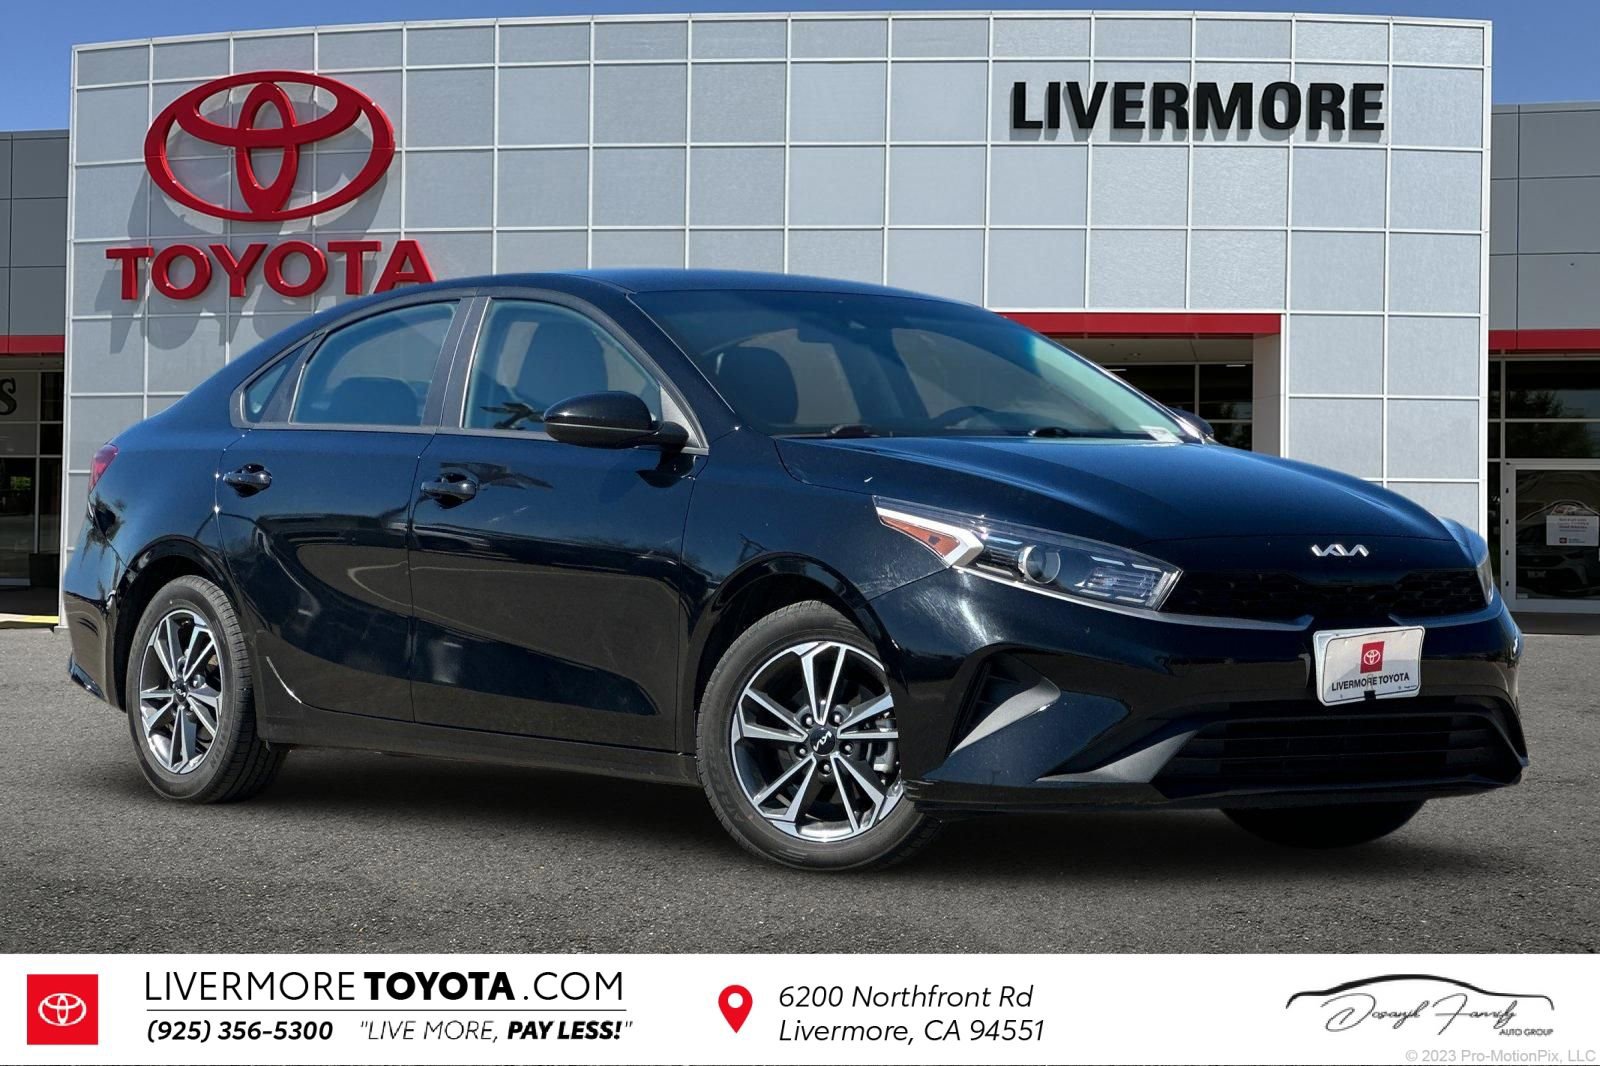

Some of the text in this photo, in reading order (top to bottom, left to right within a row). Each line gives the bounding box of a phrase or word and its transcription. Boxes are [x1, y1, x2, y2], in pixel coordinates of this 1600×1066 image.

[1012, 81, 1384, 131] LIVERMORE
[106, 240, 435, 300] TOYOTA
[1310, 543, 1369, 557] KIA
[1331, 671, 1411, 692] LIVERMORE TOYOTA
